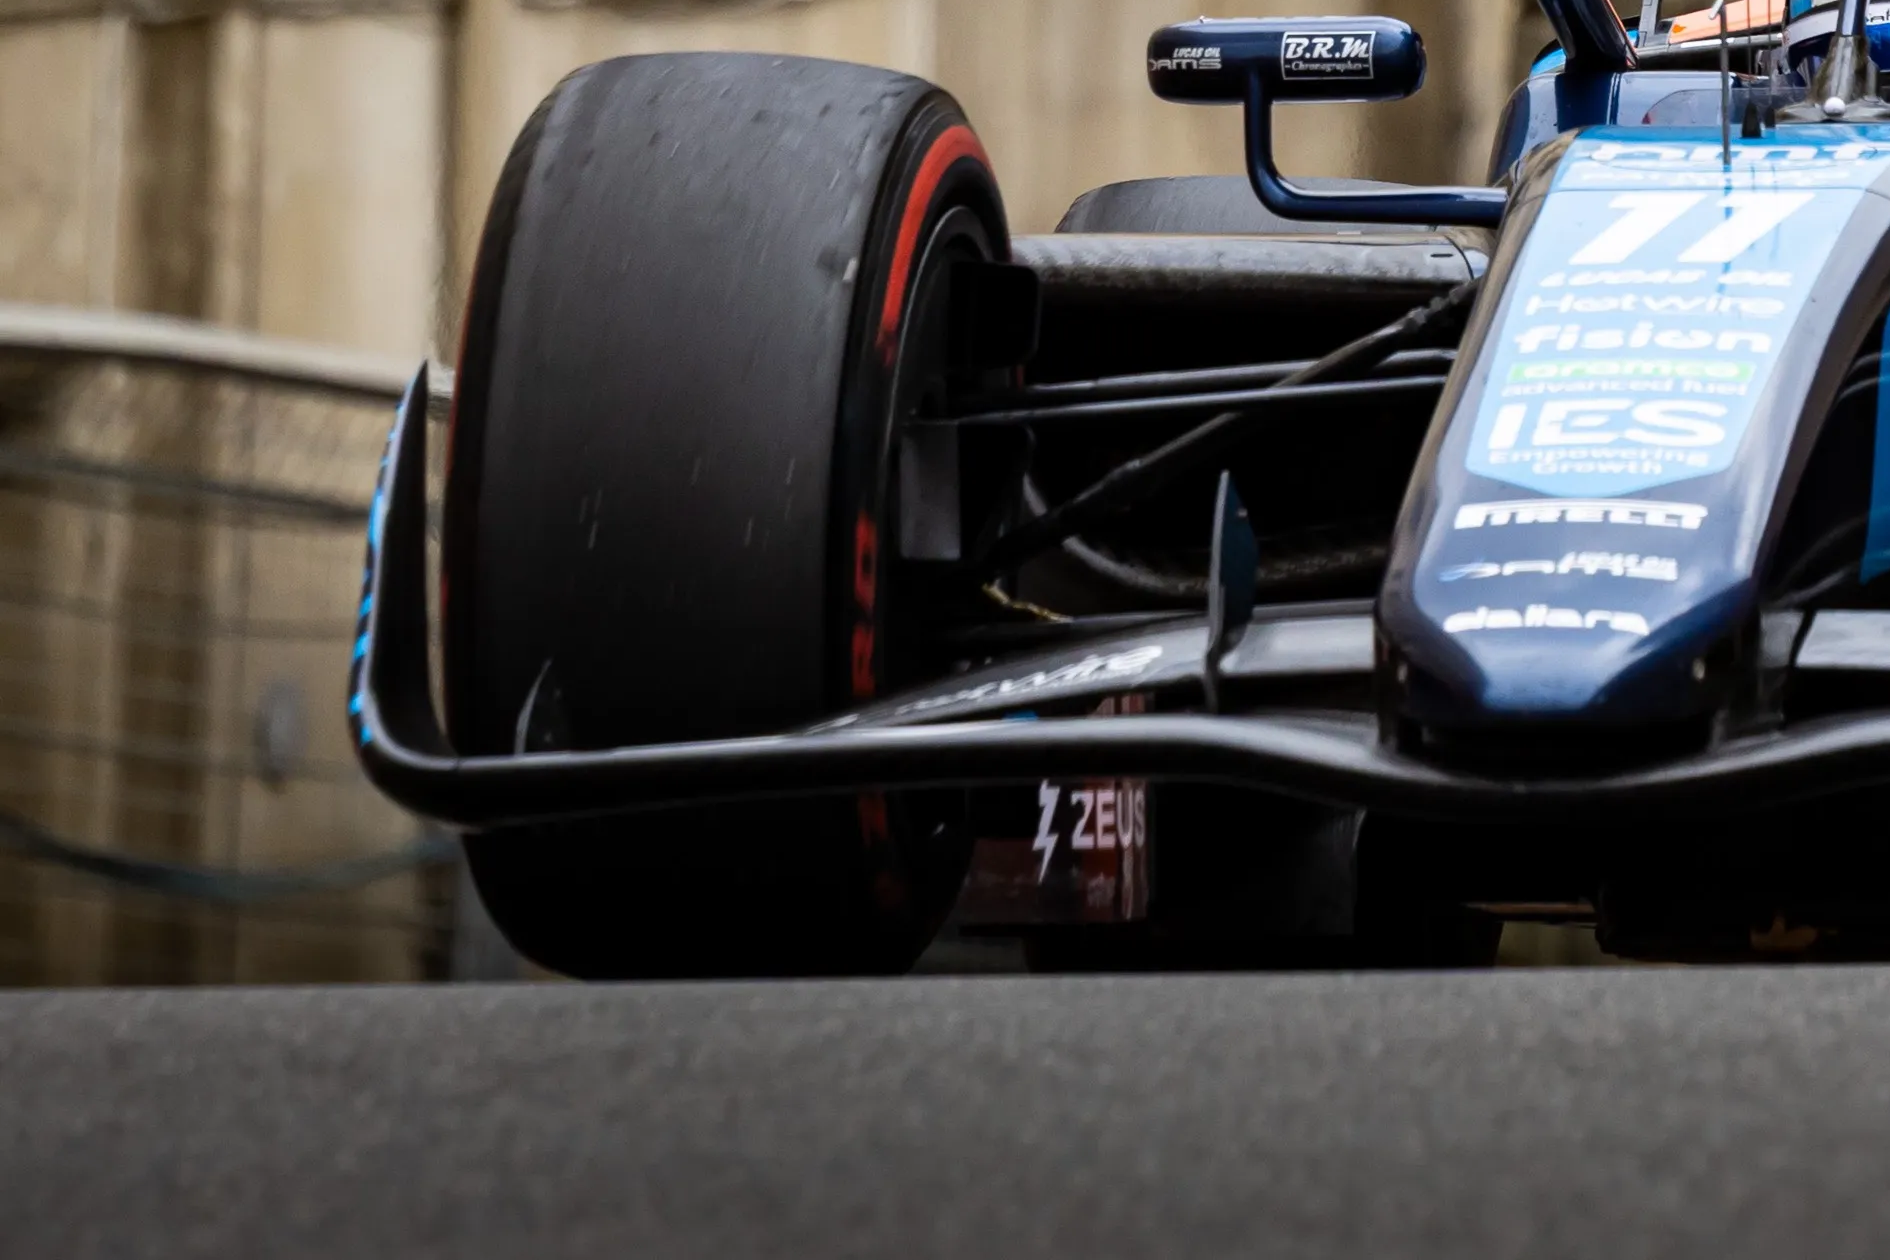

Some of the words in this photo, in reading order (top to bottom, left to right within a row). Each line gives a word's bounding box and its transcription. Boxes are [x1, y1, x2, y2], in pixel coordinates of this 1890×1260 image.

[1172, 47, 1204, 58] LUCAS
[1204, 47, 1221, 58] OIL
[1525, 293, 1785, 316] Hotwire
[1523, 360, 1741, 378] aramco
[1487, 398, 1728, 449] IES
[1488, 446, 1711, 467] Empowering
[1532, 460, 1663, 475] Growth
[1070, 789, 1146, 850] ZEUS
